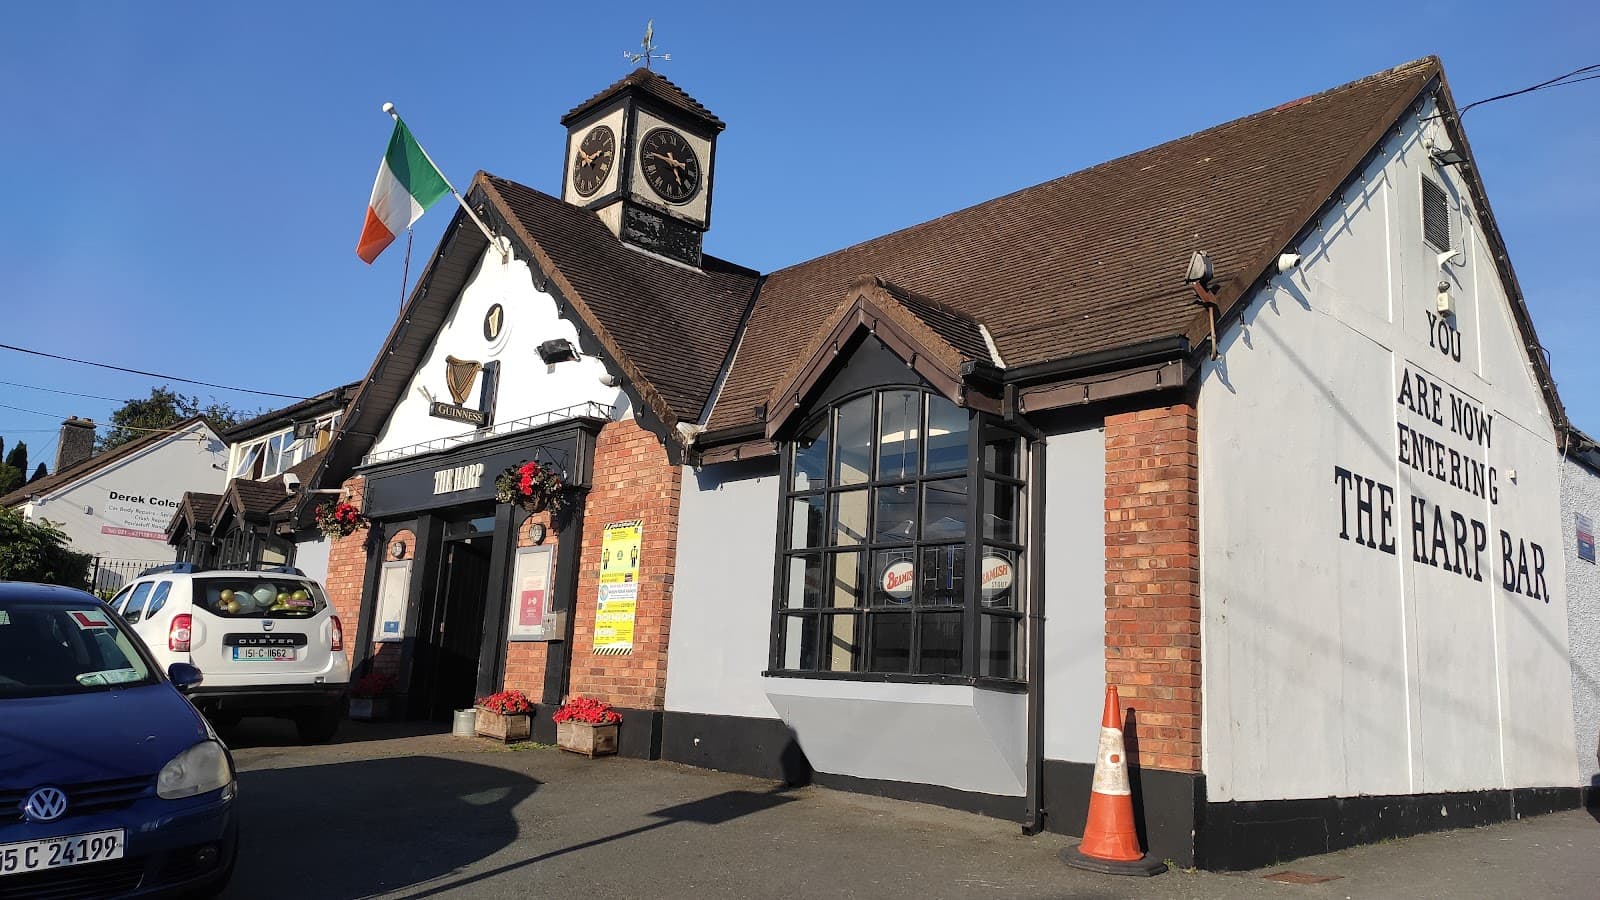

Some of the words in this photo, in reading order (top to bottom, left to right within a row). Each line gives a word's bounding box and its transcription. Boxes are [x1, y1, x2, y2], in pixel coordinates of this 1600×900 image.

[1425, 309, 1461, 363] YOU
[438, 403, 483, 422] GUINNESS
[1397, 367, 1443, 427] ARE
[1449, 392, 1493, 449] NOW
[433, 468, 455, 495] THE
[453, 463, 485, 492] HARP
[1397, 421, 1498, 505] ENTERING
[109, 491, 145, 504] Derek
[1334, 465, 1396, 555] THE
[1410, 494, 1487, 583] HARP
[1499, 529, 1550, 604] BAR
[887, 570, 913, 589] BEAMIS
[982, 564, 1008, 584] EAMISH
[72, 612, 109, 627] L
[25, 846, 39, 869] C
[48, 835, 116, 866] 24199
